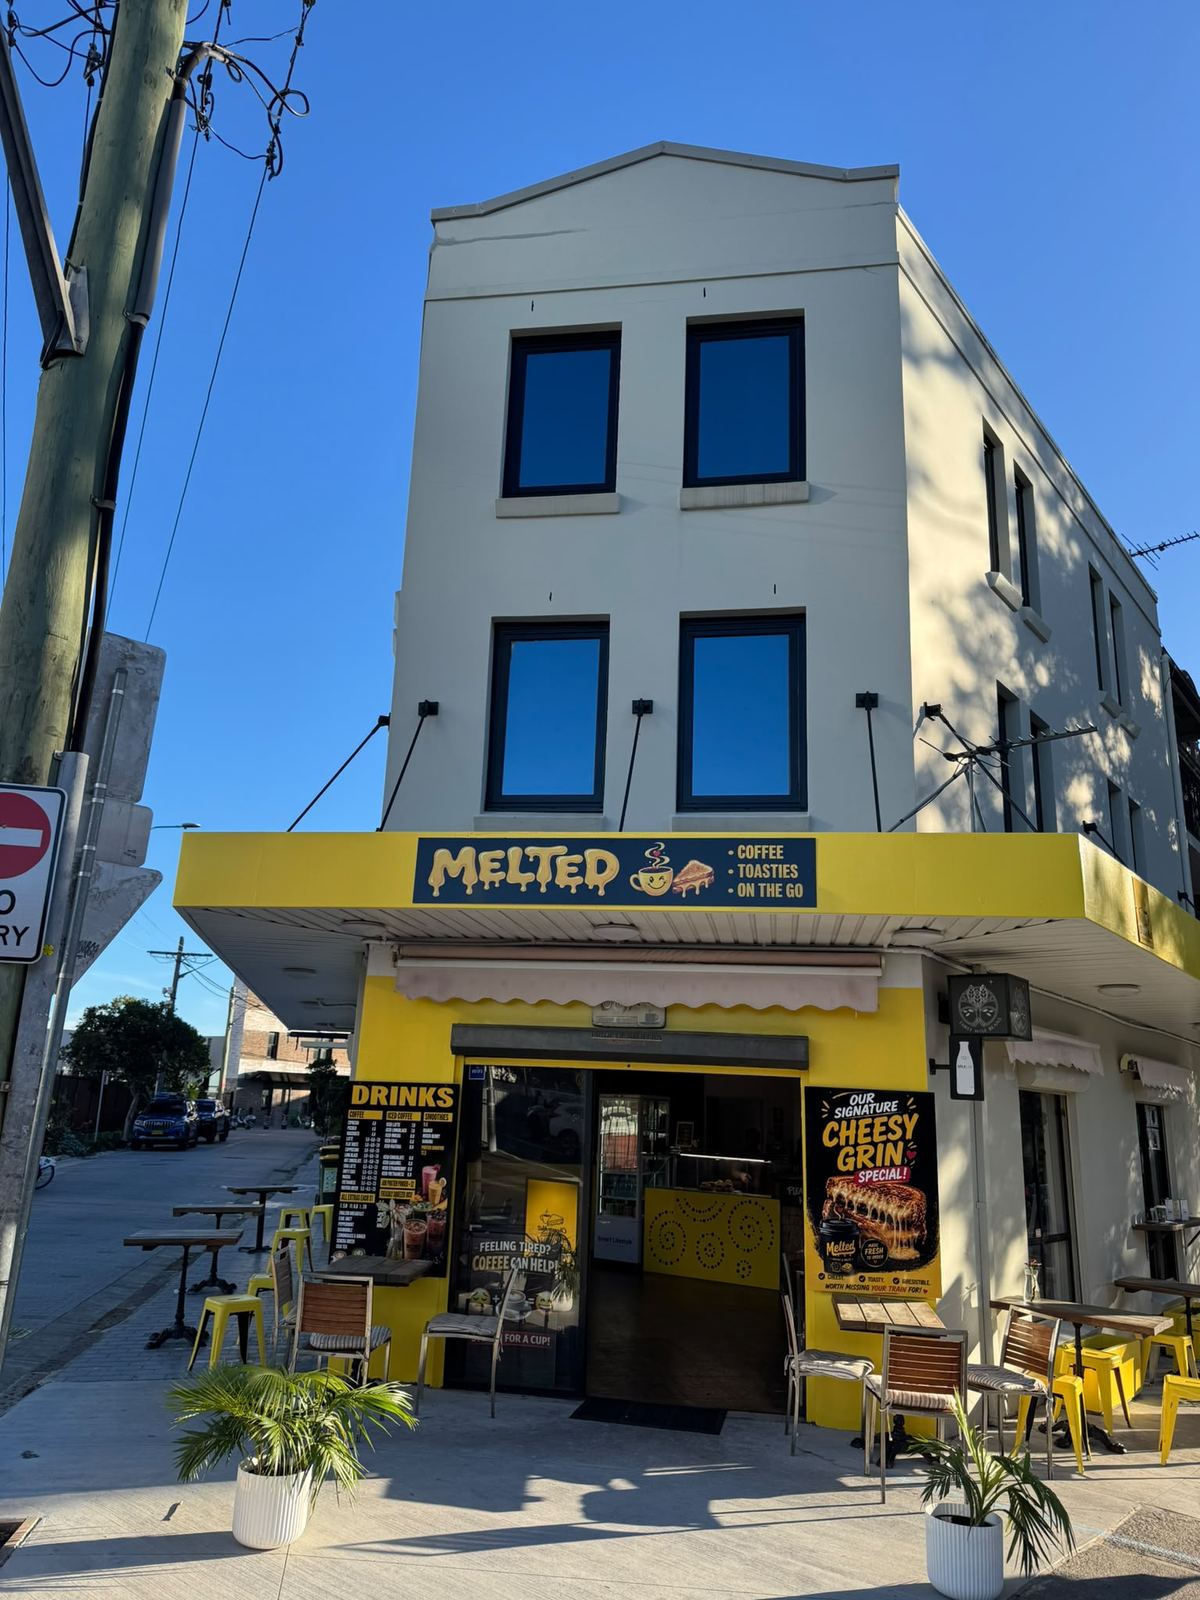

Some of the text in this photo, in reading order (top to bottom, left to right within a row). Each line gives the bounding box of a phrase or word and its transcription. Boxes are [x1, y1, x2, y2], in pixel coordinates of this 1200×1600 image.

[737, 844, 784, 859] COFFEE
[428, 846, 620, 897] MELTED
[737, 863, 799, 879] TOASTIES
[737, 882, 804, 898] ON THE GO
[351, 1084, 454, 1108] DRINKS
[849, 1092, 875, 1106] OUR
[349, 1111, 365, 1119] COFFEE
[398, 1112, 413, 1120] COFFEE
[834, 1100, 899, 1119] SIGNATURE
[822, 1112, 920, 1148] CHEESY
[837, 1141, 904, 1172] GRIN
[858, 1167, 908, 1183] SPECIAL!
[479, 1241, 552, 1255] FEELING TIRED?
[826, 1239, 856, 1257] Melted
[864, 1247, 884, 1256] FRESH
[472, 1255, 559, 1274] COFFEE CAN HELP!
[907, 1286, 923, 1294] FOR!
[504, 1333, 551, 1346] FOR A CUP!
